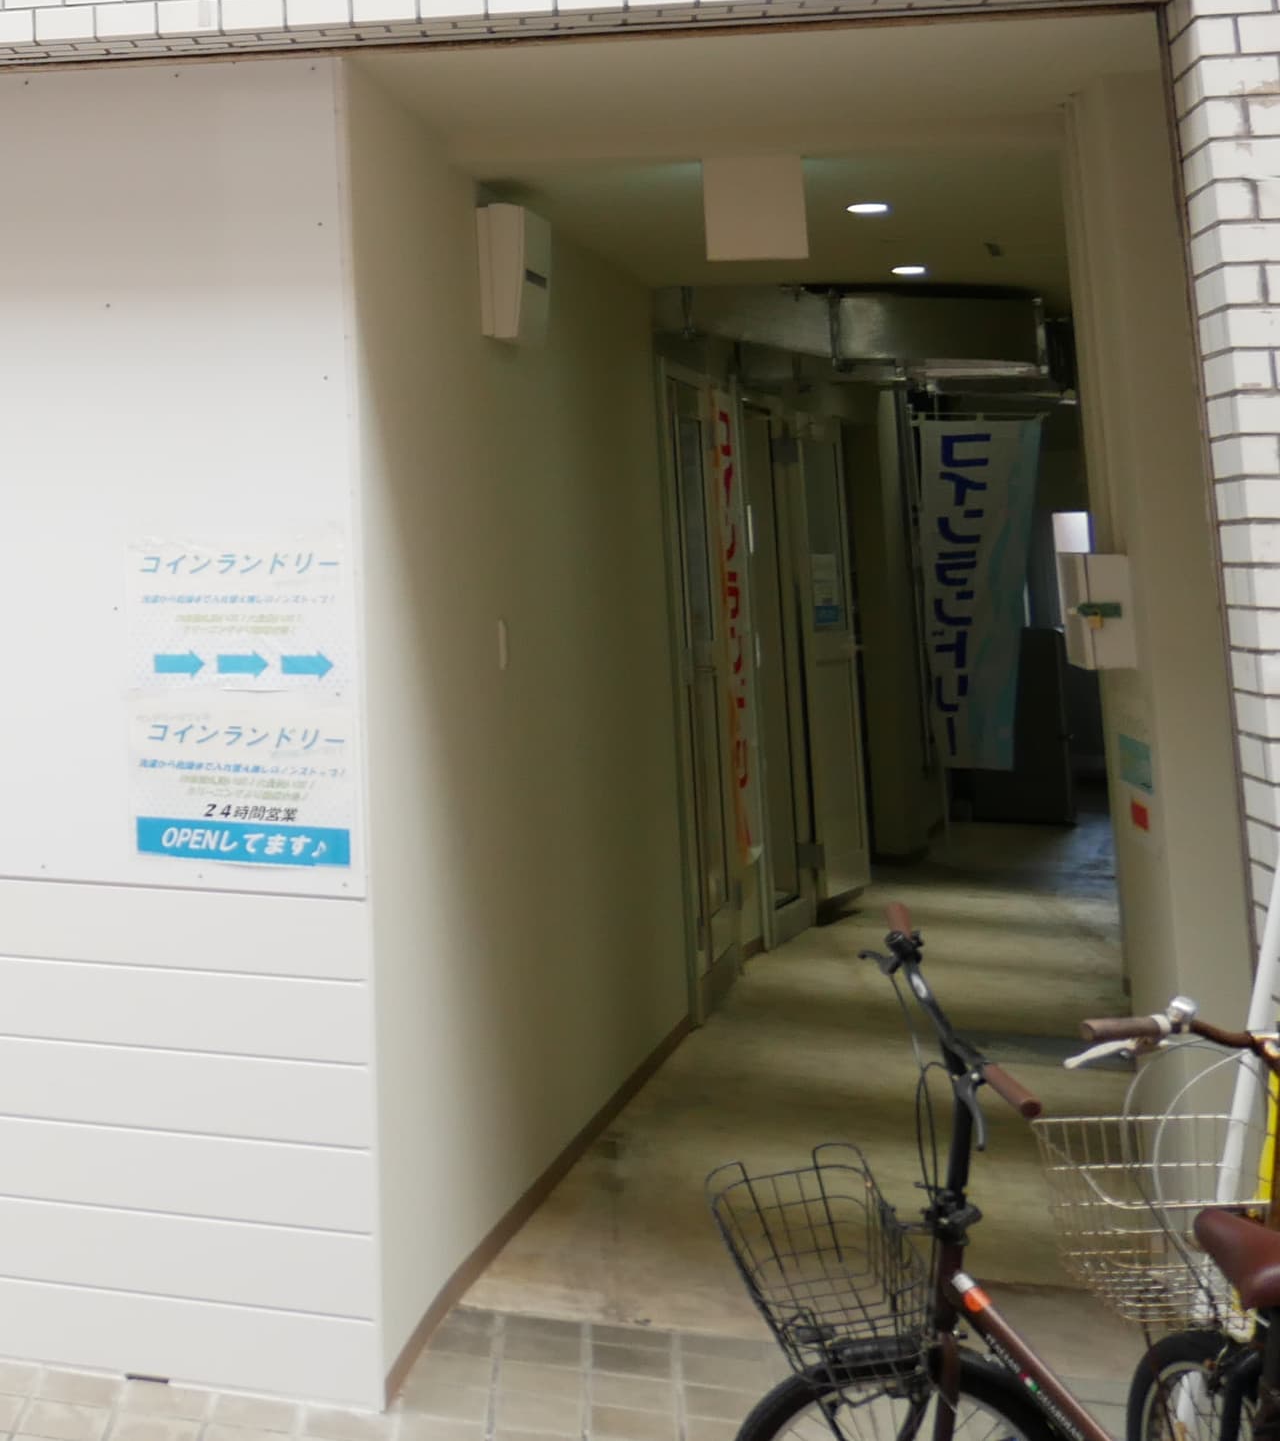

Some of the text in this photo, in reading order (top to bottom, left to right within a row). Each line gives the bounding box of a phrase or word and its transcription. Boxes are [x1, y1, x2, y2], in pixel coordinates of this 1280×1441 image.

[139, 551, 340, 575] コインランドリー
[148, 721, 345, 750] コインランドリー
